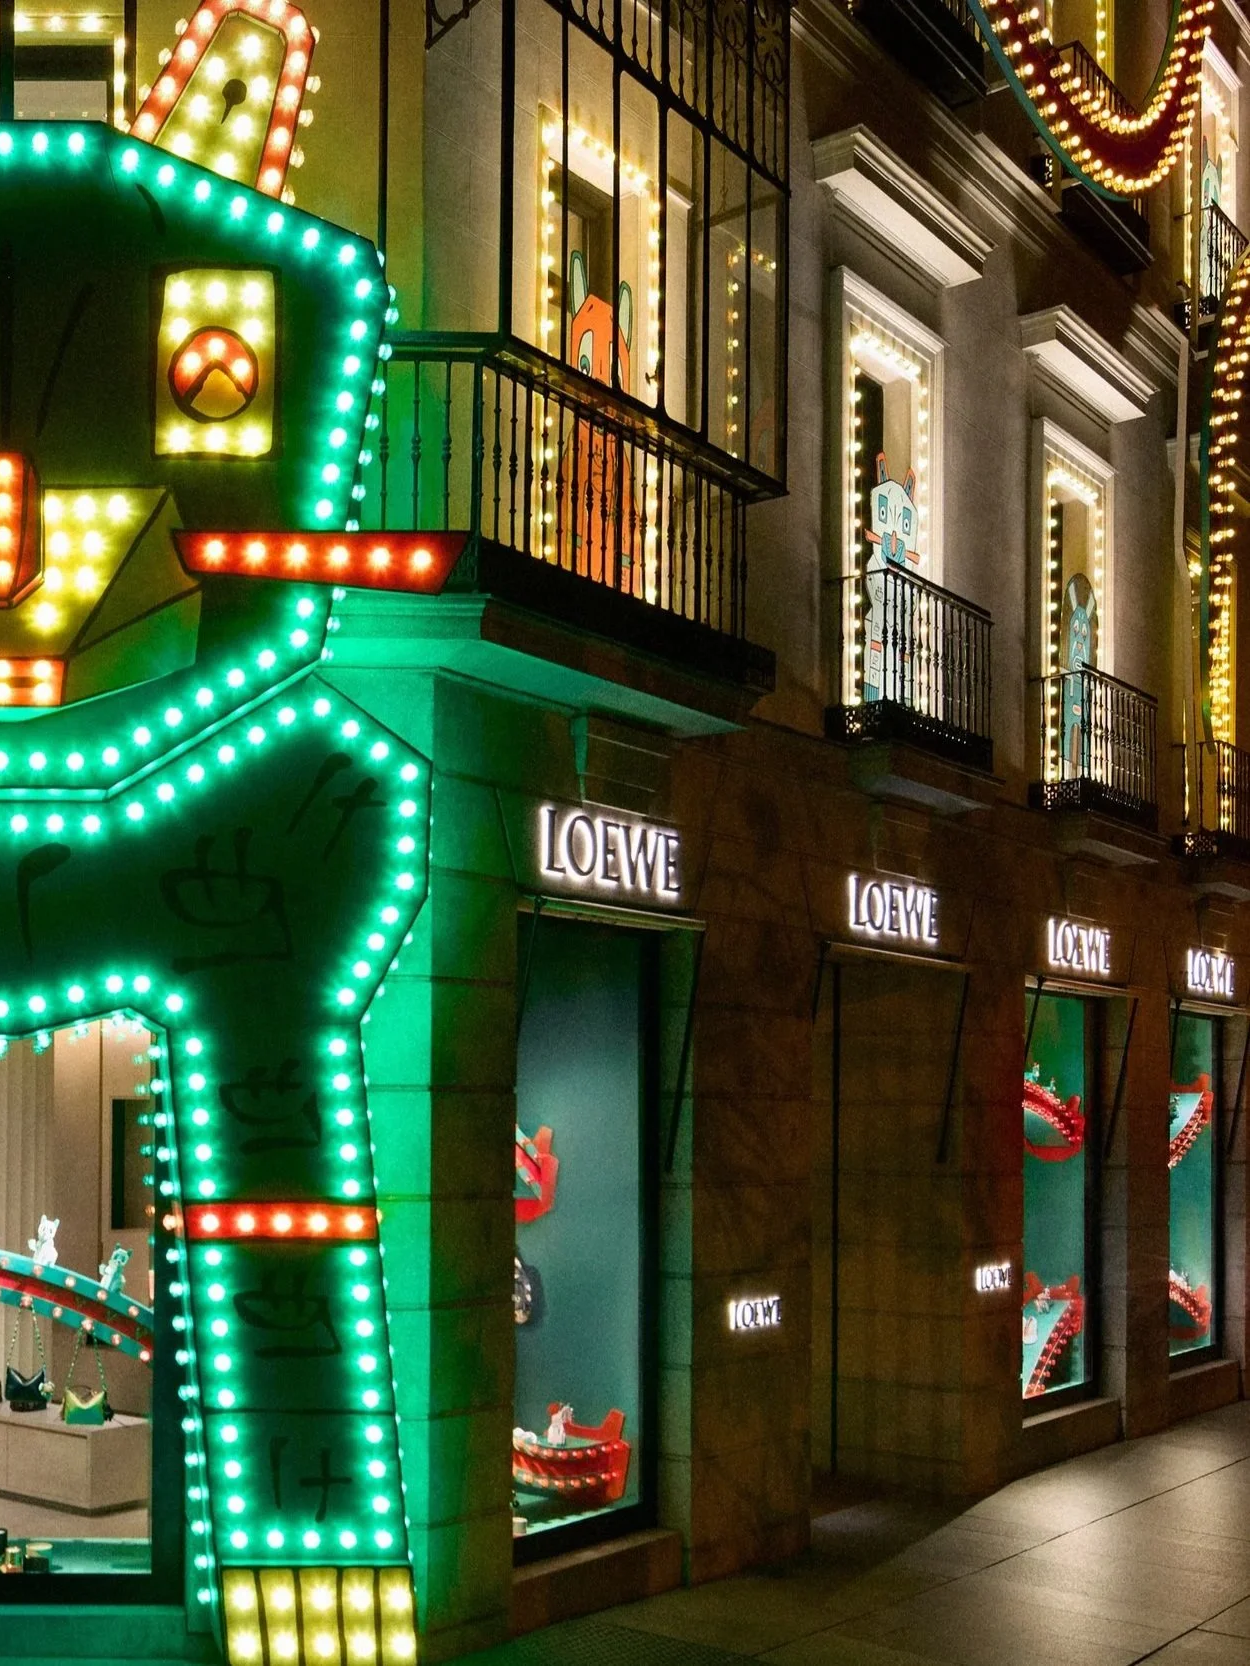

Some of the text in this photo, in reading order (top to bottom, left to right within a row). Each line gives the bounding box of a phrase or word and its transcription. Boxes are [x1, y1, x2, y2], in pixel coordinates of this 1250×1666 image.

[540, 807, 681, 896] LOEWE
[848, 874, 939, 943] LOEWE
[1048, 917, 1112, 973] LOEWE
